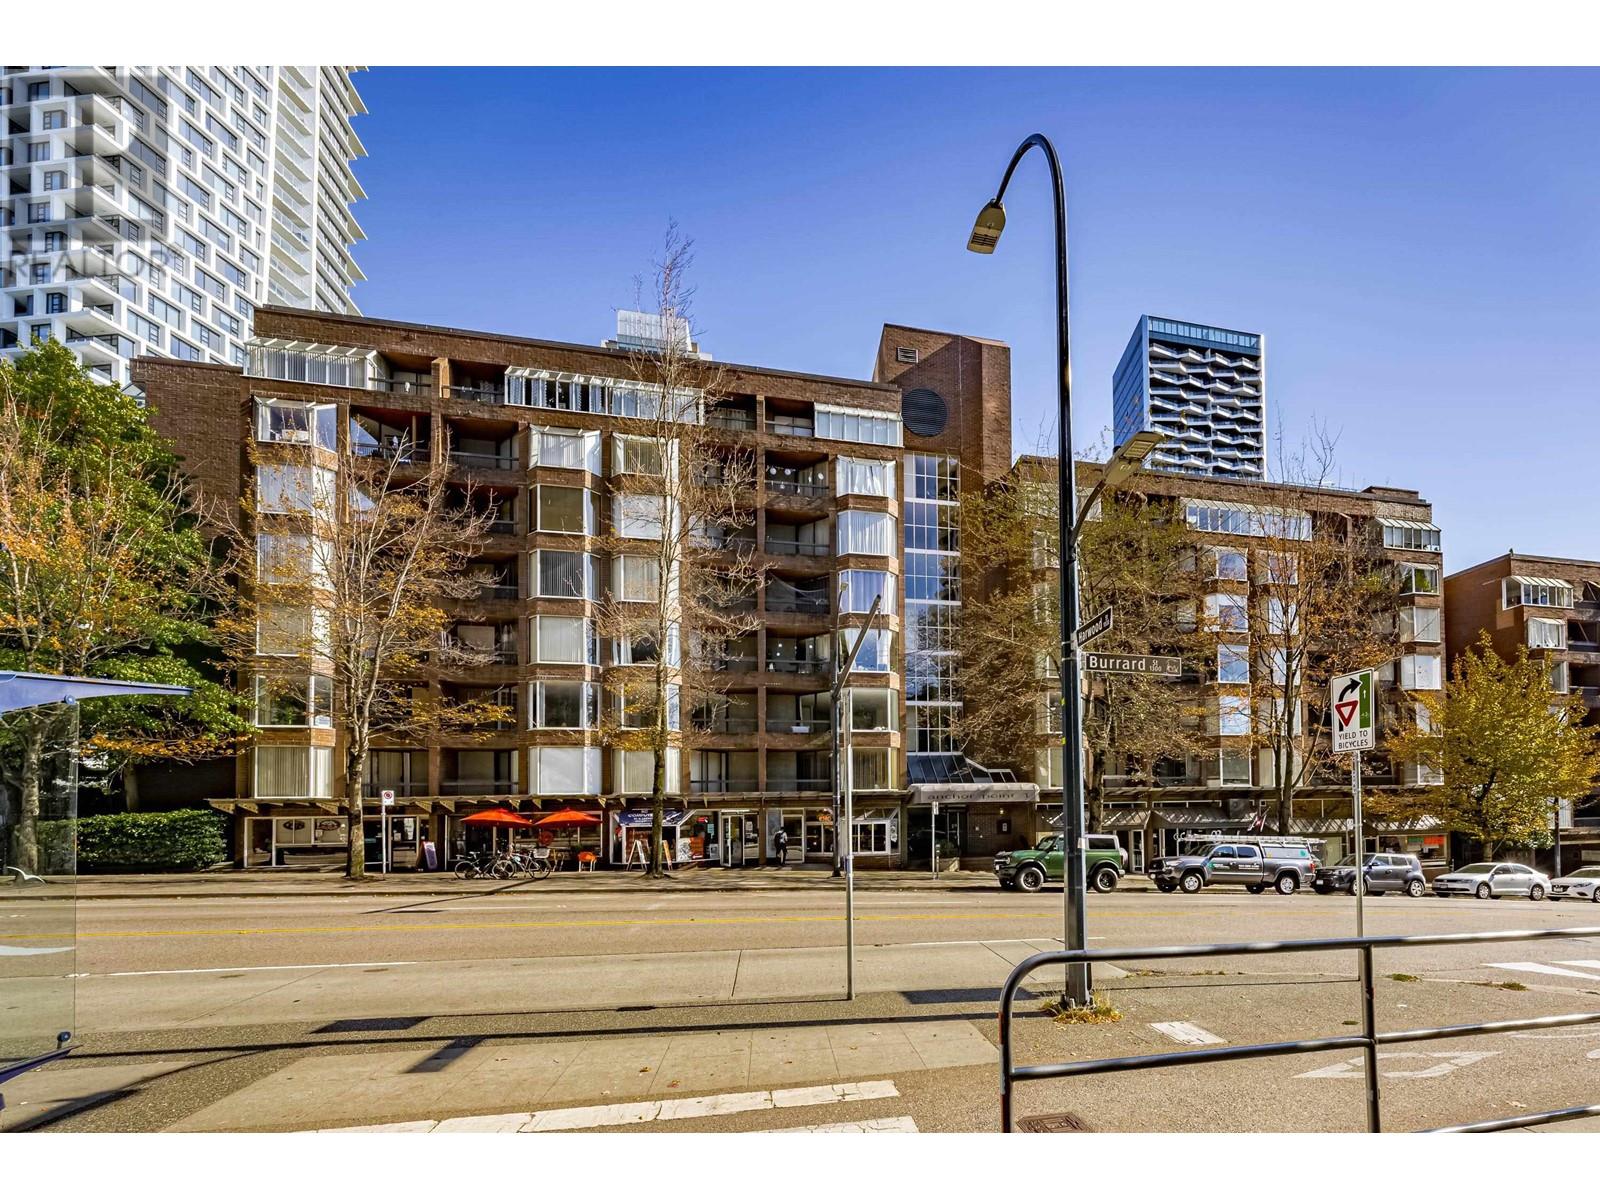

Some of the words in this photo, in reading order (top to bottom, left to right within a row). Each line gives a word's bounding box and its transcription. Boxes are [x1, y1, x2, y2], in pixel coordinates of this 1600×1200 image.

[1089, 656, 1146, 671] Burrard
[1338, 732, 1356, 740] YIELD
[1338, 740, 1368, 749] BICYCLES
